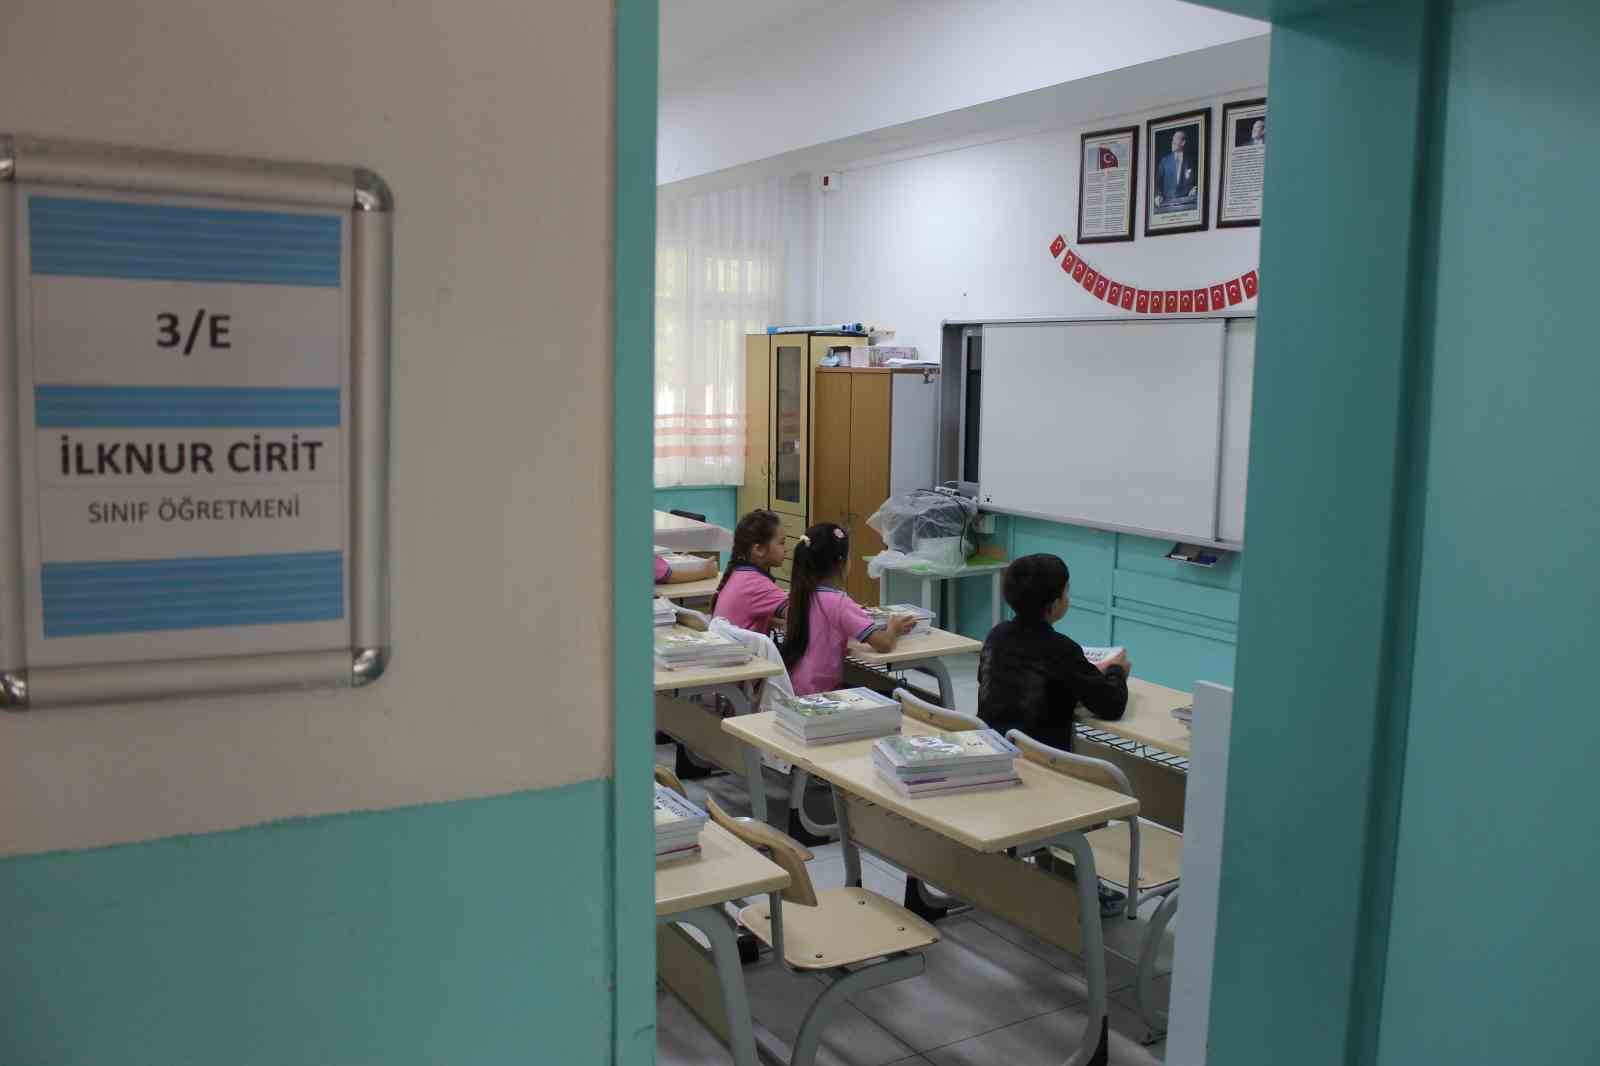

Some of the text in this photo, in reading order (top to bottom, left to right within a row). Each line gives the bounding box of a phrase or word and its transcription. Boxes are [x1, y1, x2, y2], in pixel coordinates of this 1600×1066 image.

[156, 309, 232, 356] 3/E
[61, 433, 323, 476] İLKNUR CİRİT
[88, 495, 300, 524] SINIF ÖĞRETMENİ
